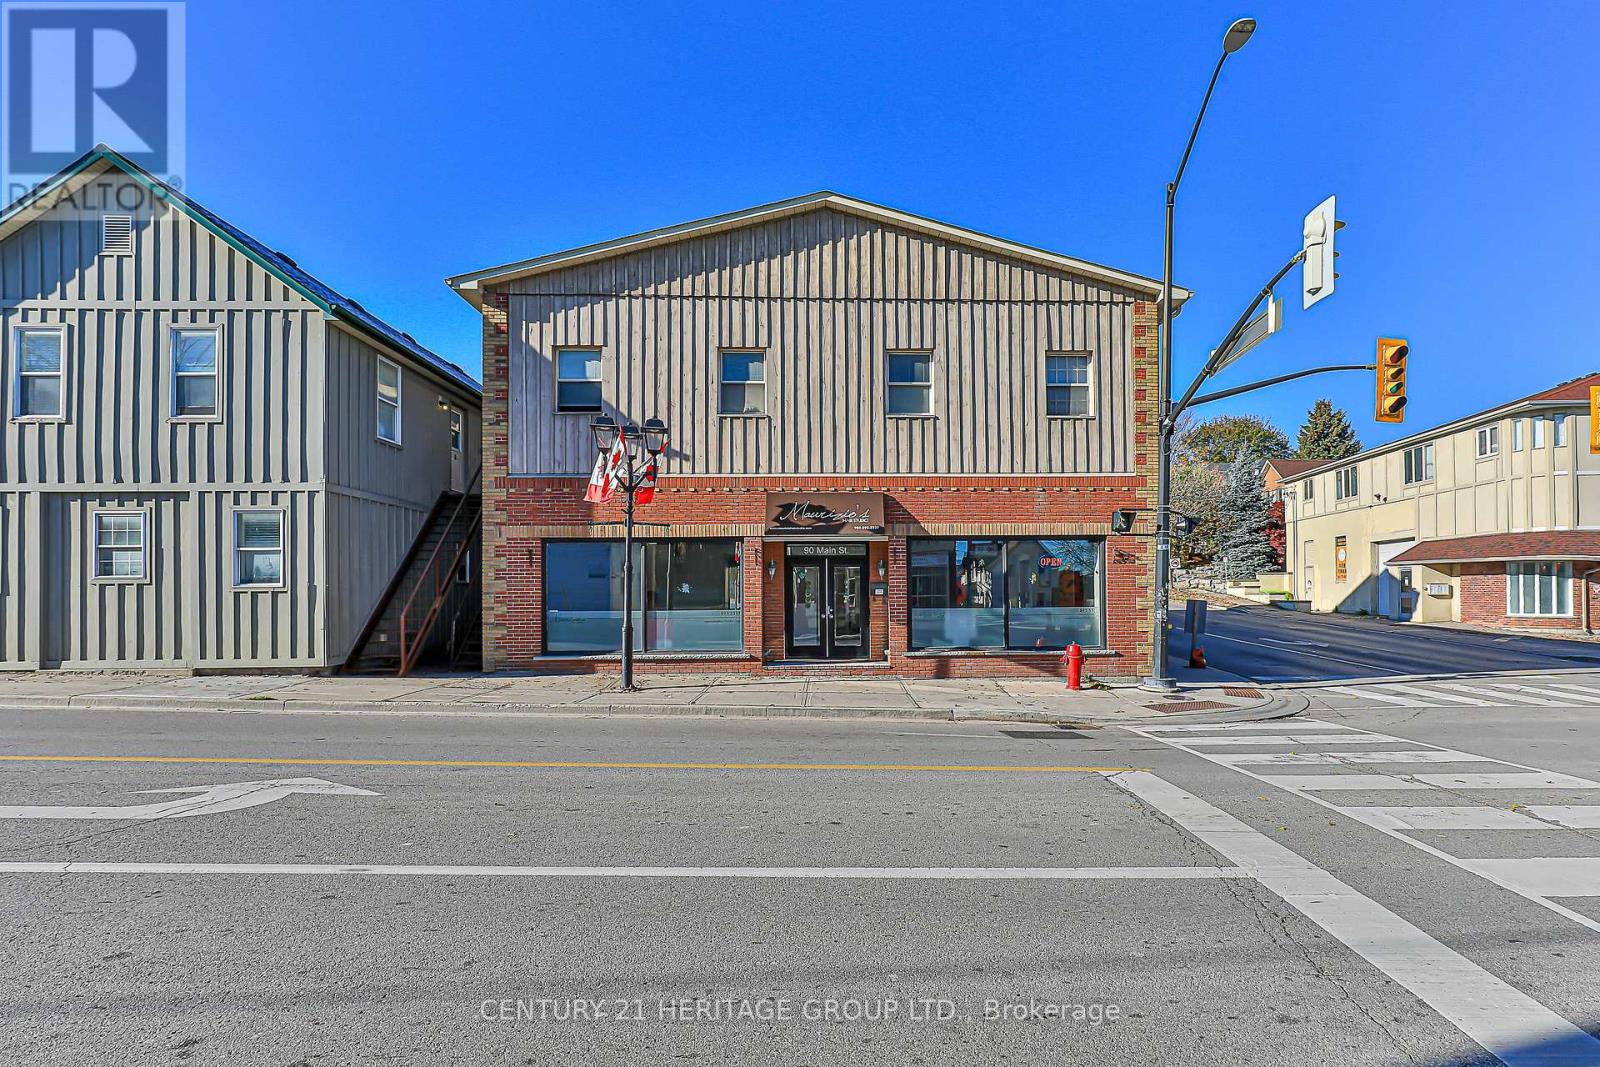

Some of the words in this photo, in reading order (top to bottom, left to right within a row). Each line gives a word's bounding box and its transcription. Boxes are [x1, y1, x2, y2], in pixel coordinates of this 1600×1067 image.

[803, 546, 814, 555] 90
[816, 546, 836, 555] Main
[1040, 557, 1062, 566] OPEN
